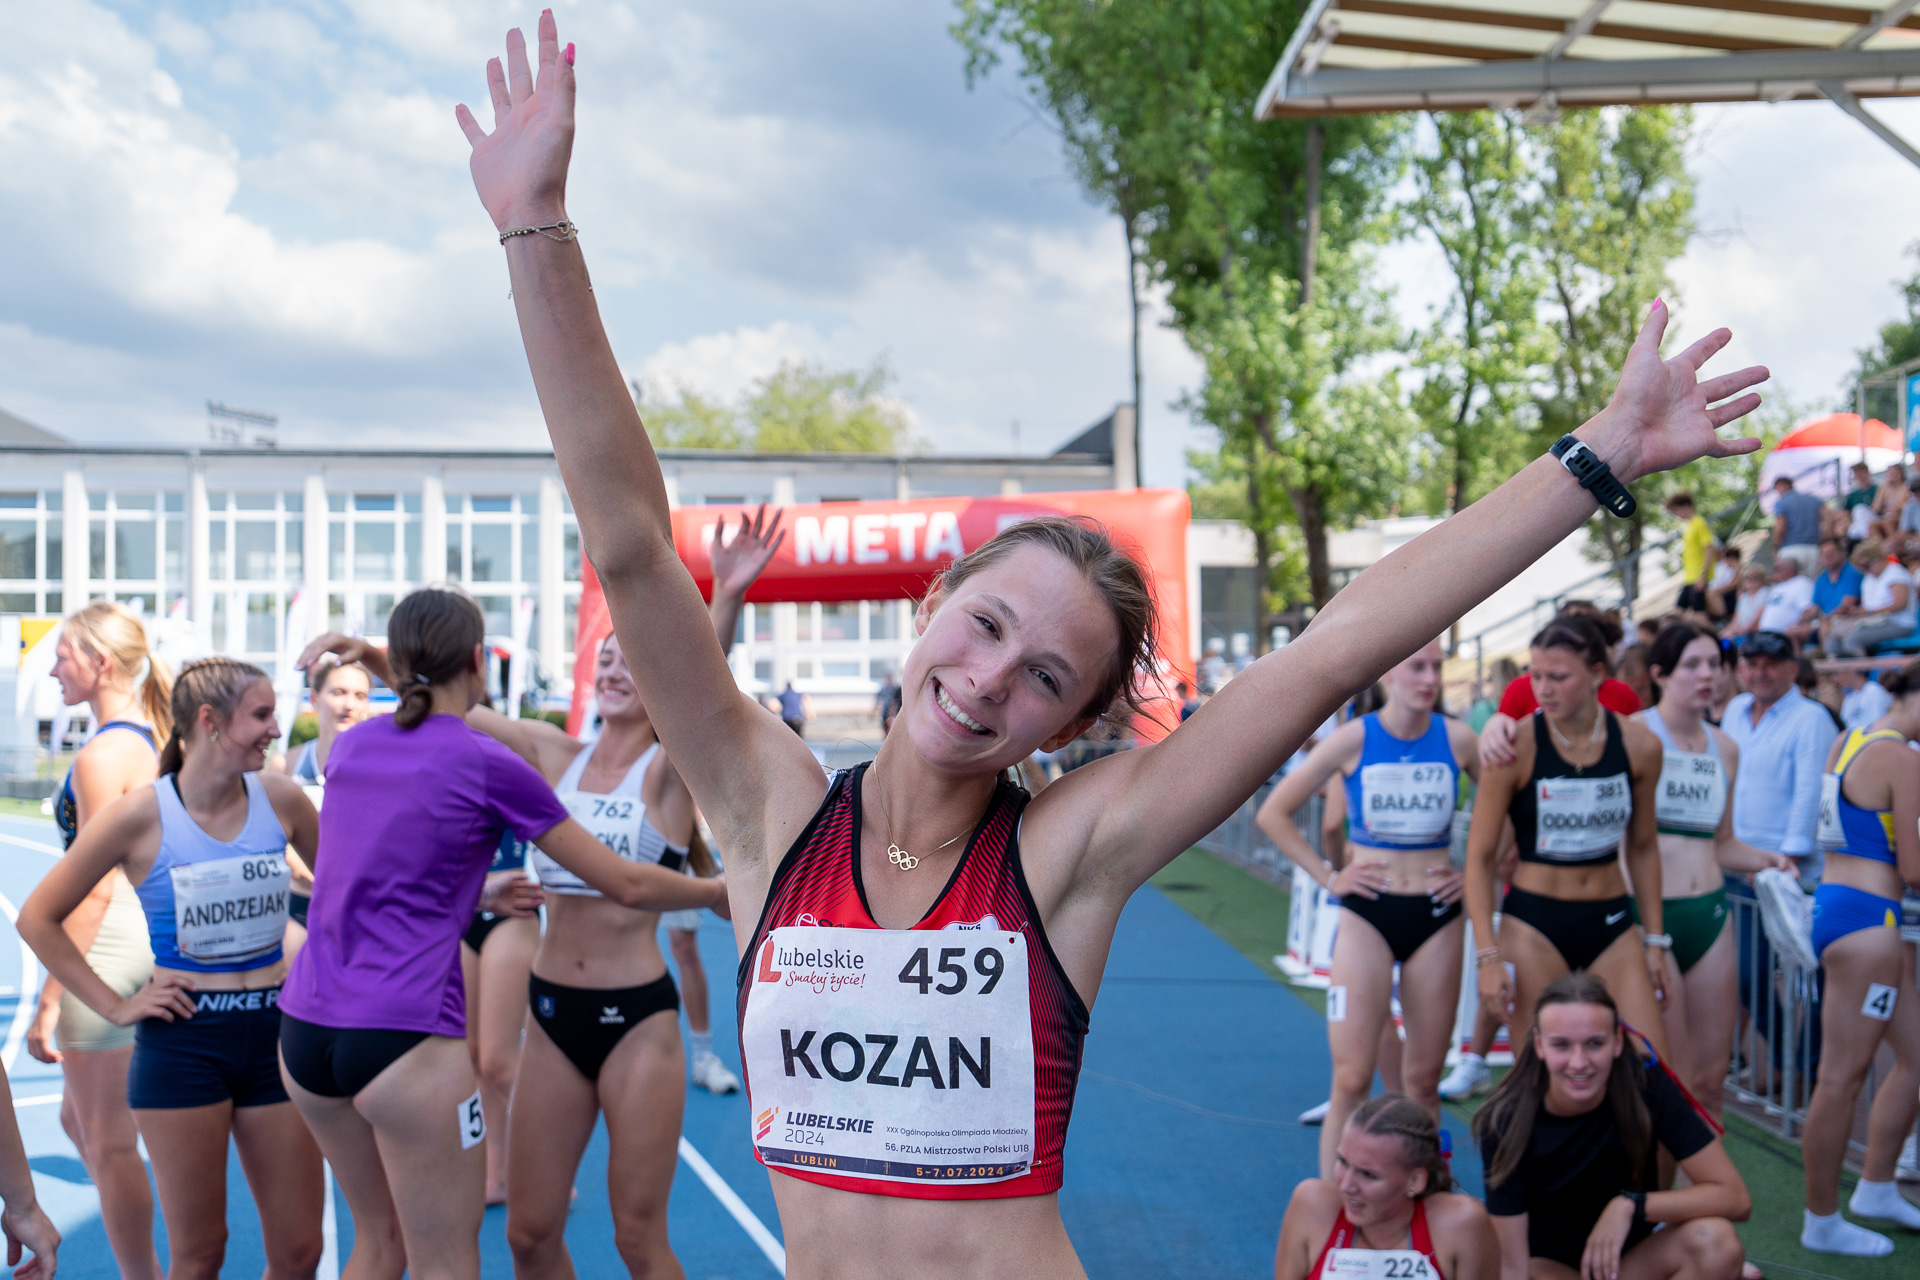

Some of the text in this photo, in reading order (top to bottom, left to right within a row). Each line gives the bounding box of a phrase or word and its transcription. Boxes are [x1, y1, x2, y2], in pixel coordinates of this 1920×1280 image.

[794, 511, 965, 566] META
[1413, 766, 1445, 783] 677
[1666, 780, 1711, 801] BANY
[592, 799, 633, 819] 762
[243, 859, 282, 881] 803
[182, 890, 286, 929] ANDRZEJAK
[898, 946, 1005, 995] 459
[785, 970, 829, 994] Smakuj
[198, 991, 263, 1012] NIKE
[1871, 990, 1890, 1014] 4
[780, 1029, 991, 1090] KOZAN
[469, 1098, 484, 1138] 5
[786, 1111, 875, 1134] LUBELSKIE
[784, 1128, 825, 1146] 2024
[886, 1126, 899, 1134] XXX
[900, 1127, 950, 1138] Ogólnopolska
[951, 1129, 991, 1138] Olimpiada
[885, 1142, 1030, 1155] 56. PZLA Mistrzostwa Polski U18
[793, 1153, 838, 1168] LUBLIN
[916, 1166, 1004, 1178] 5-7.07.2024
[1384, 1257, 1429, 1278] 224
